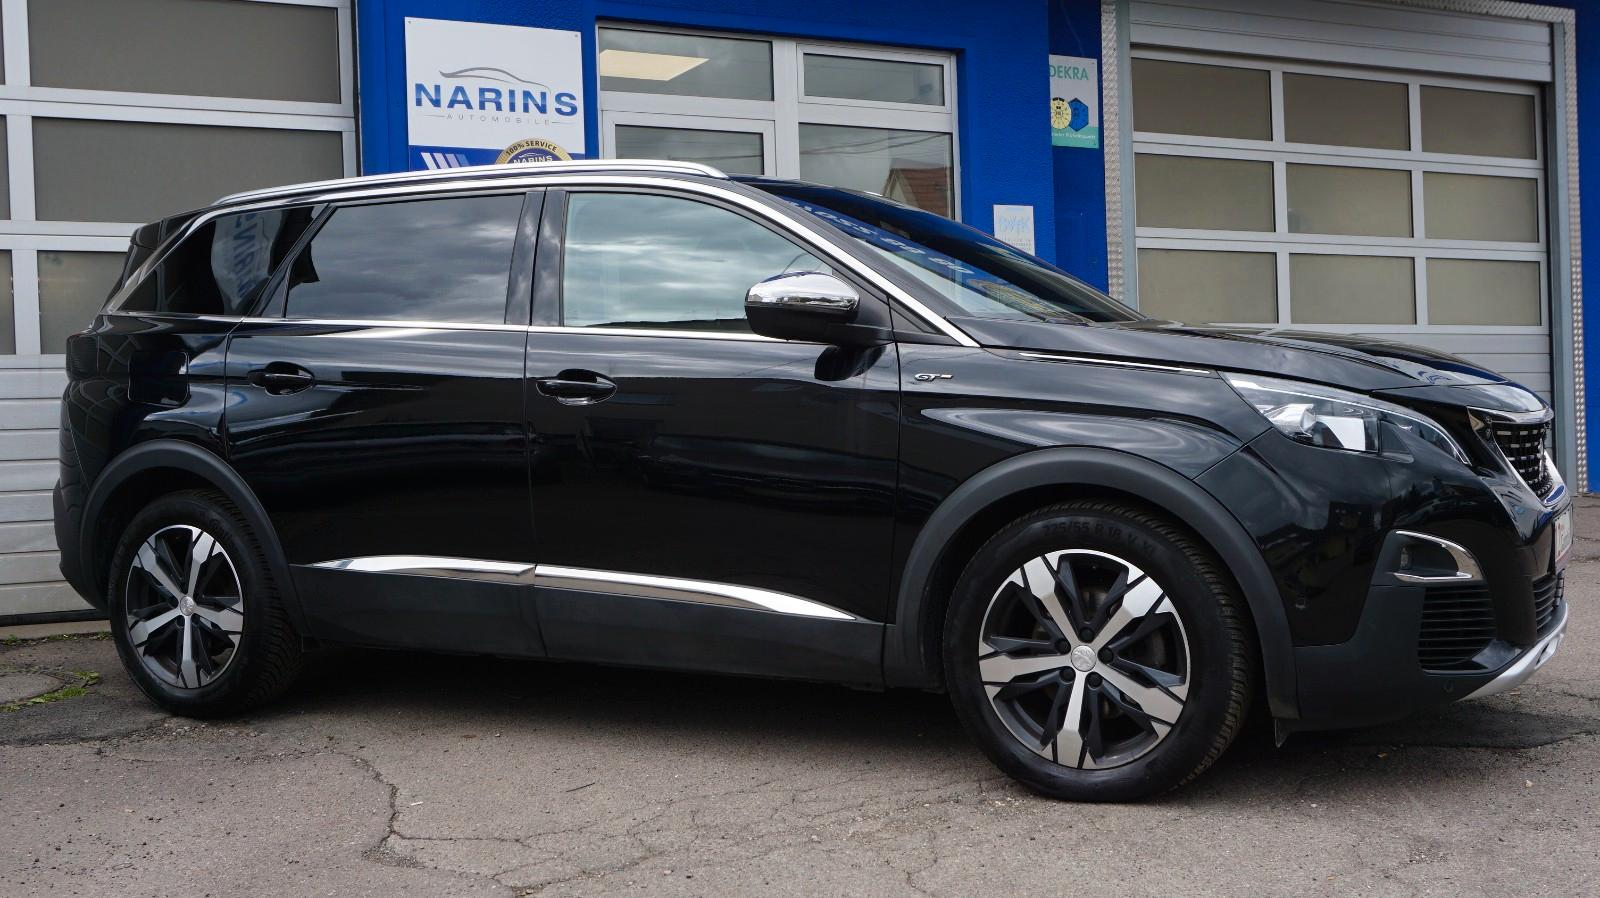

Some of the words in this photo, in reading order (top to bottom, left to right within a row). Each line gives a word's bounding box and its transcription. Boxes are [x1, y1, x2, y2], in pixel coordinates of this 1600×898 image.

[1049, 65, 1089, 80] DEKRA
[415, 83, 578, 117] NARINS
[446, 114, 550, 126] AUTOMOBILE
[505, 143, 525, 156] 100%
[525, 140, 557, 153] SERVICE
